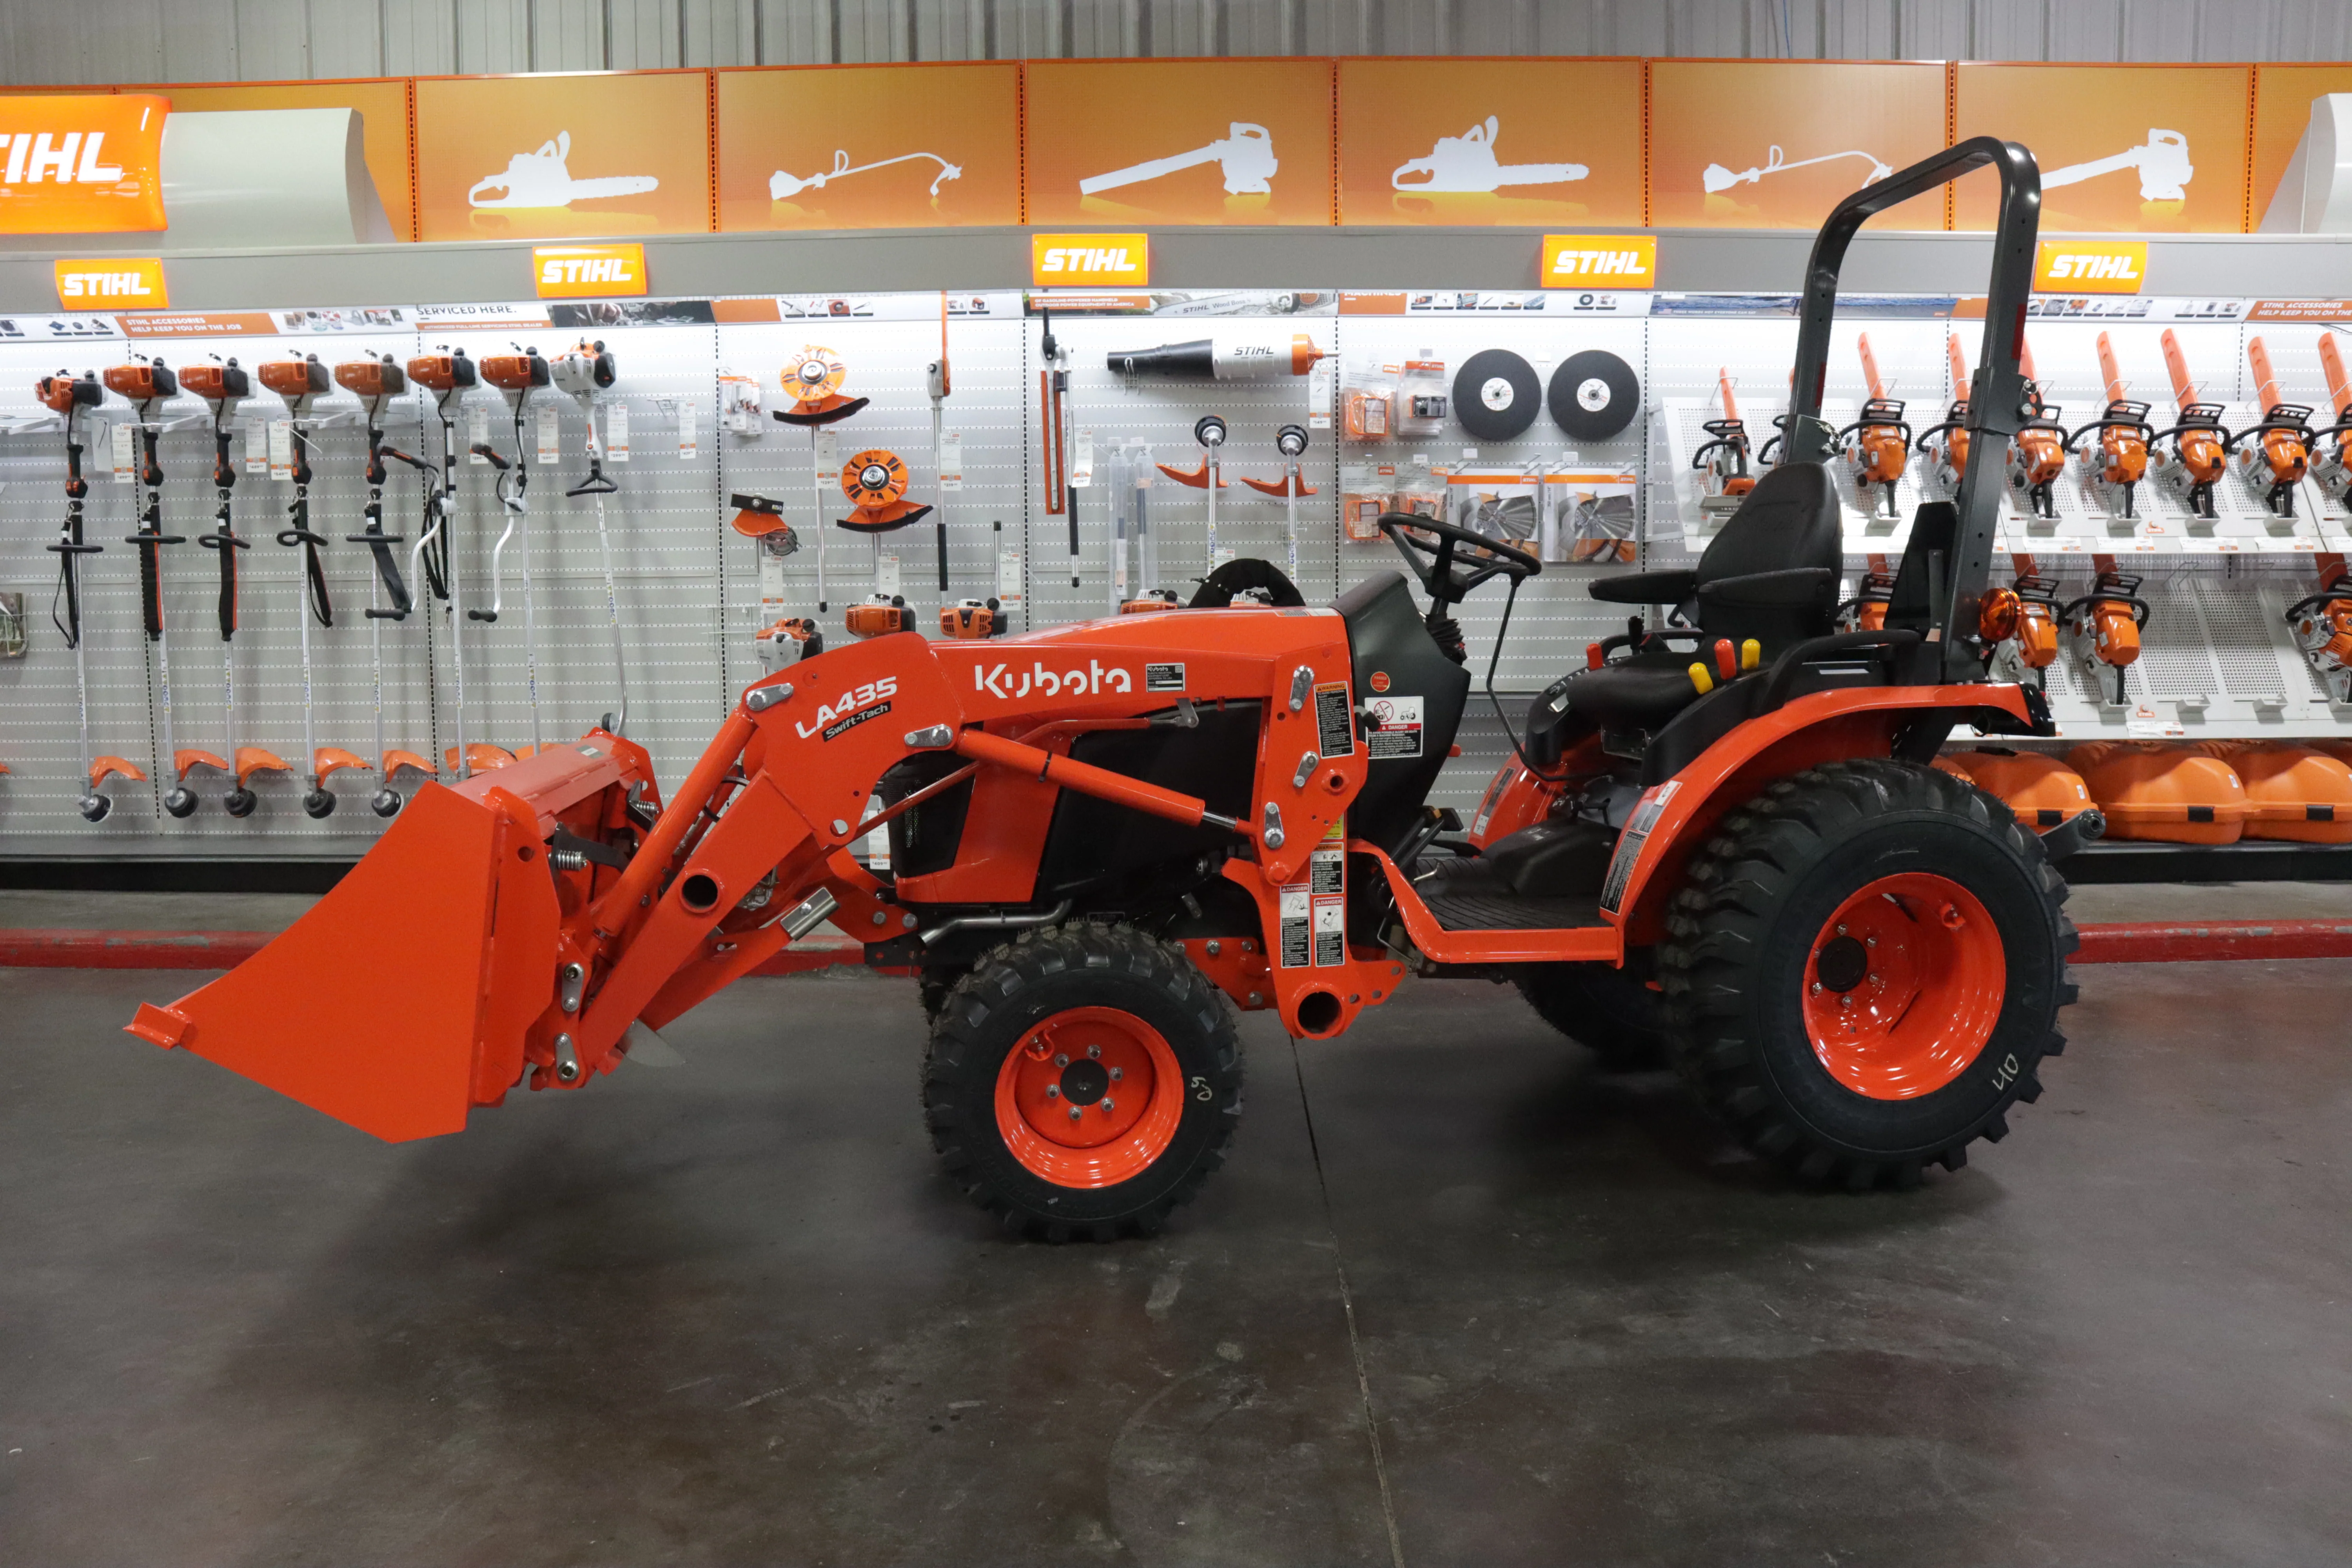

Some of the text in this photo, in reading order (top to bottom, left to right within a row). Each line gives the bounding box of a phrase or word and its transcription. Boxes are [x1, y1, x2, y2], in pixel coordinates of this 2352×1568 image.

[0, 132, 122, 183] IHL
[542, 259, 631, 283] STIHL
[1042, 249, 1136, 271] STIHL
[1553, 251, 1646, 273] STIHL
[2048, 255, 2138, 279] STIHL
[64, 273, 150, 296] STIHL
[418, 306, 517, 315] SERVICED HERE.
[1183, 305, 1209, 313] STIHL
[1234, 346, 1274, 356] STIHL
[975, 659, 1131, 699] Kubota
[795, 676, 897, 739] LA435
[825, 704, 888, 739] Swift-Tach
